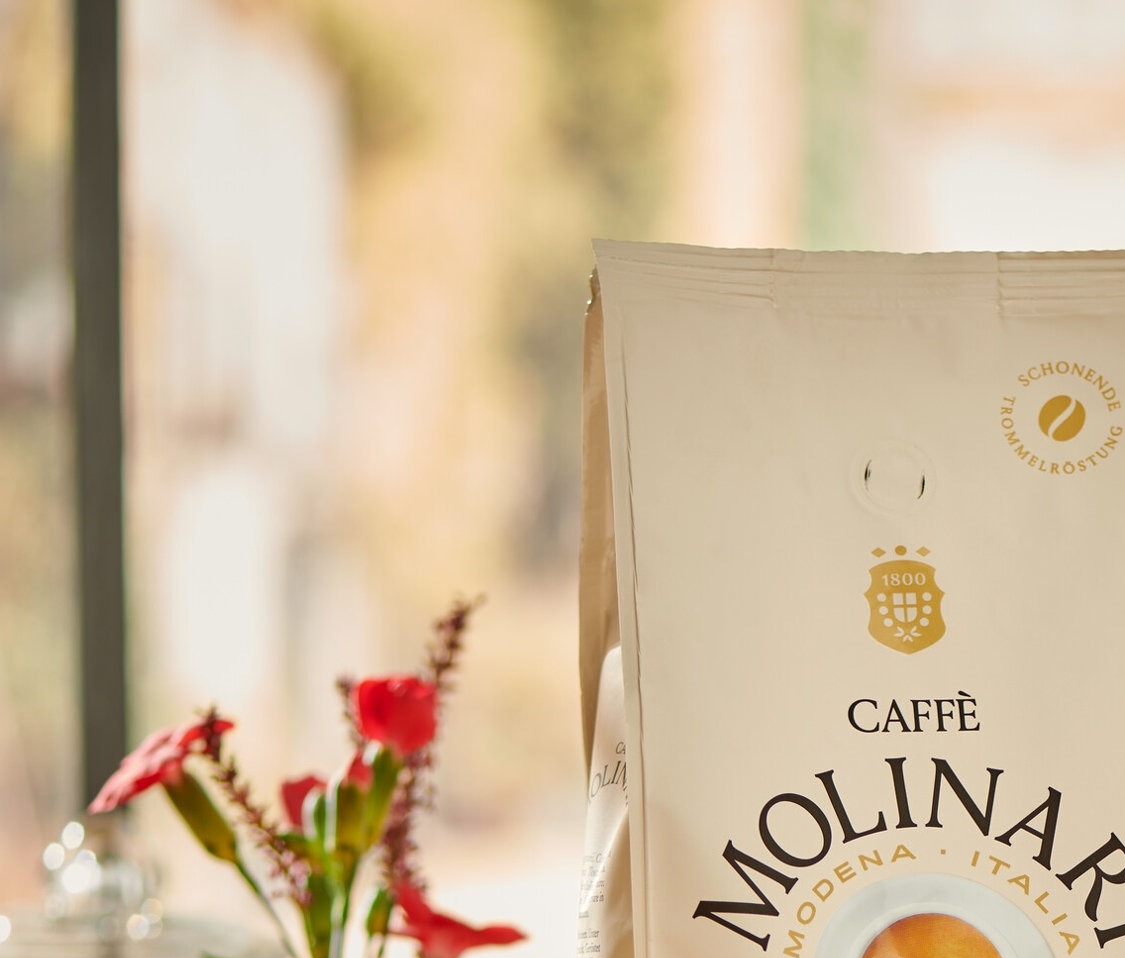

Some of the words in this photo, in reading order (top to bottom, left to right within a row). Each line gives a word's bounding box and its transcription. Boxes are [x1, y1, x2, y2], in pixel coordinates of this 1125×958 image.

[1017, 360, 1122, 412] SCHONENDE
[1000, 395, 1124, 475] TROMMELRÖSTUNG
[881, 572, 927, 587] 1800
[847, 690, 981, 733] CAFFÈ
[970, 850, 1082, 956] ITALIA
